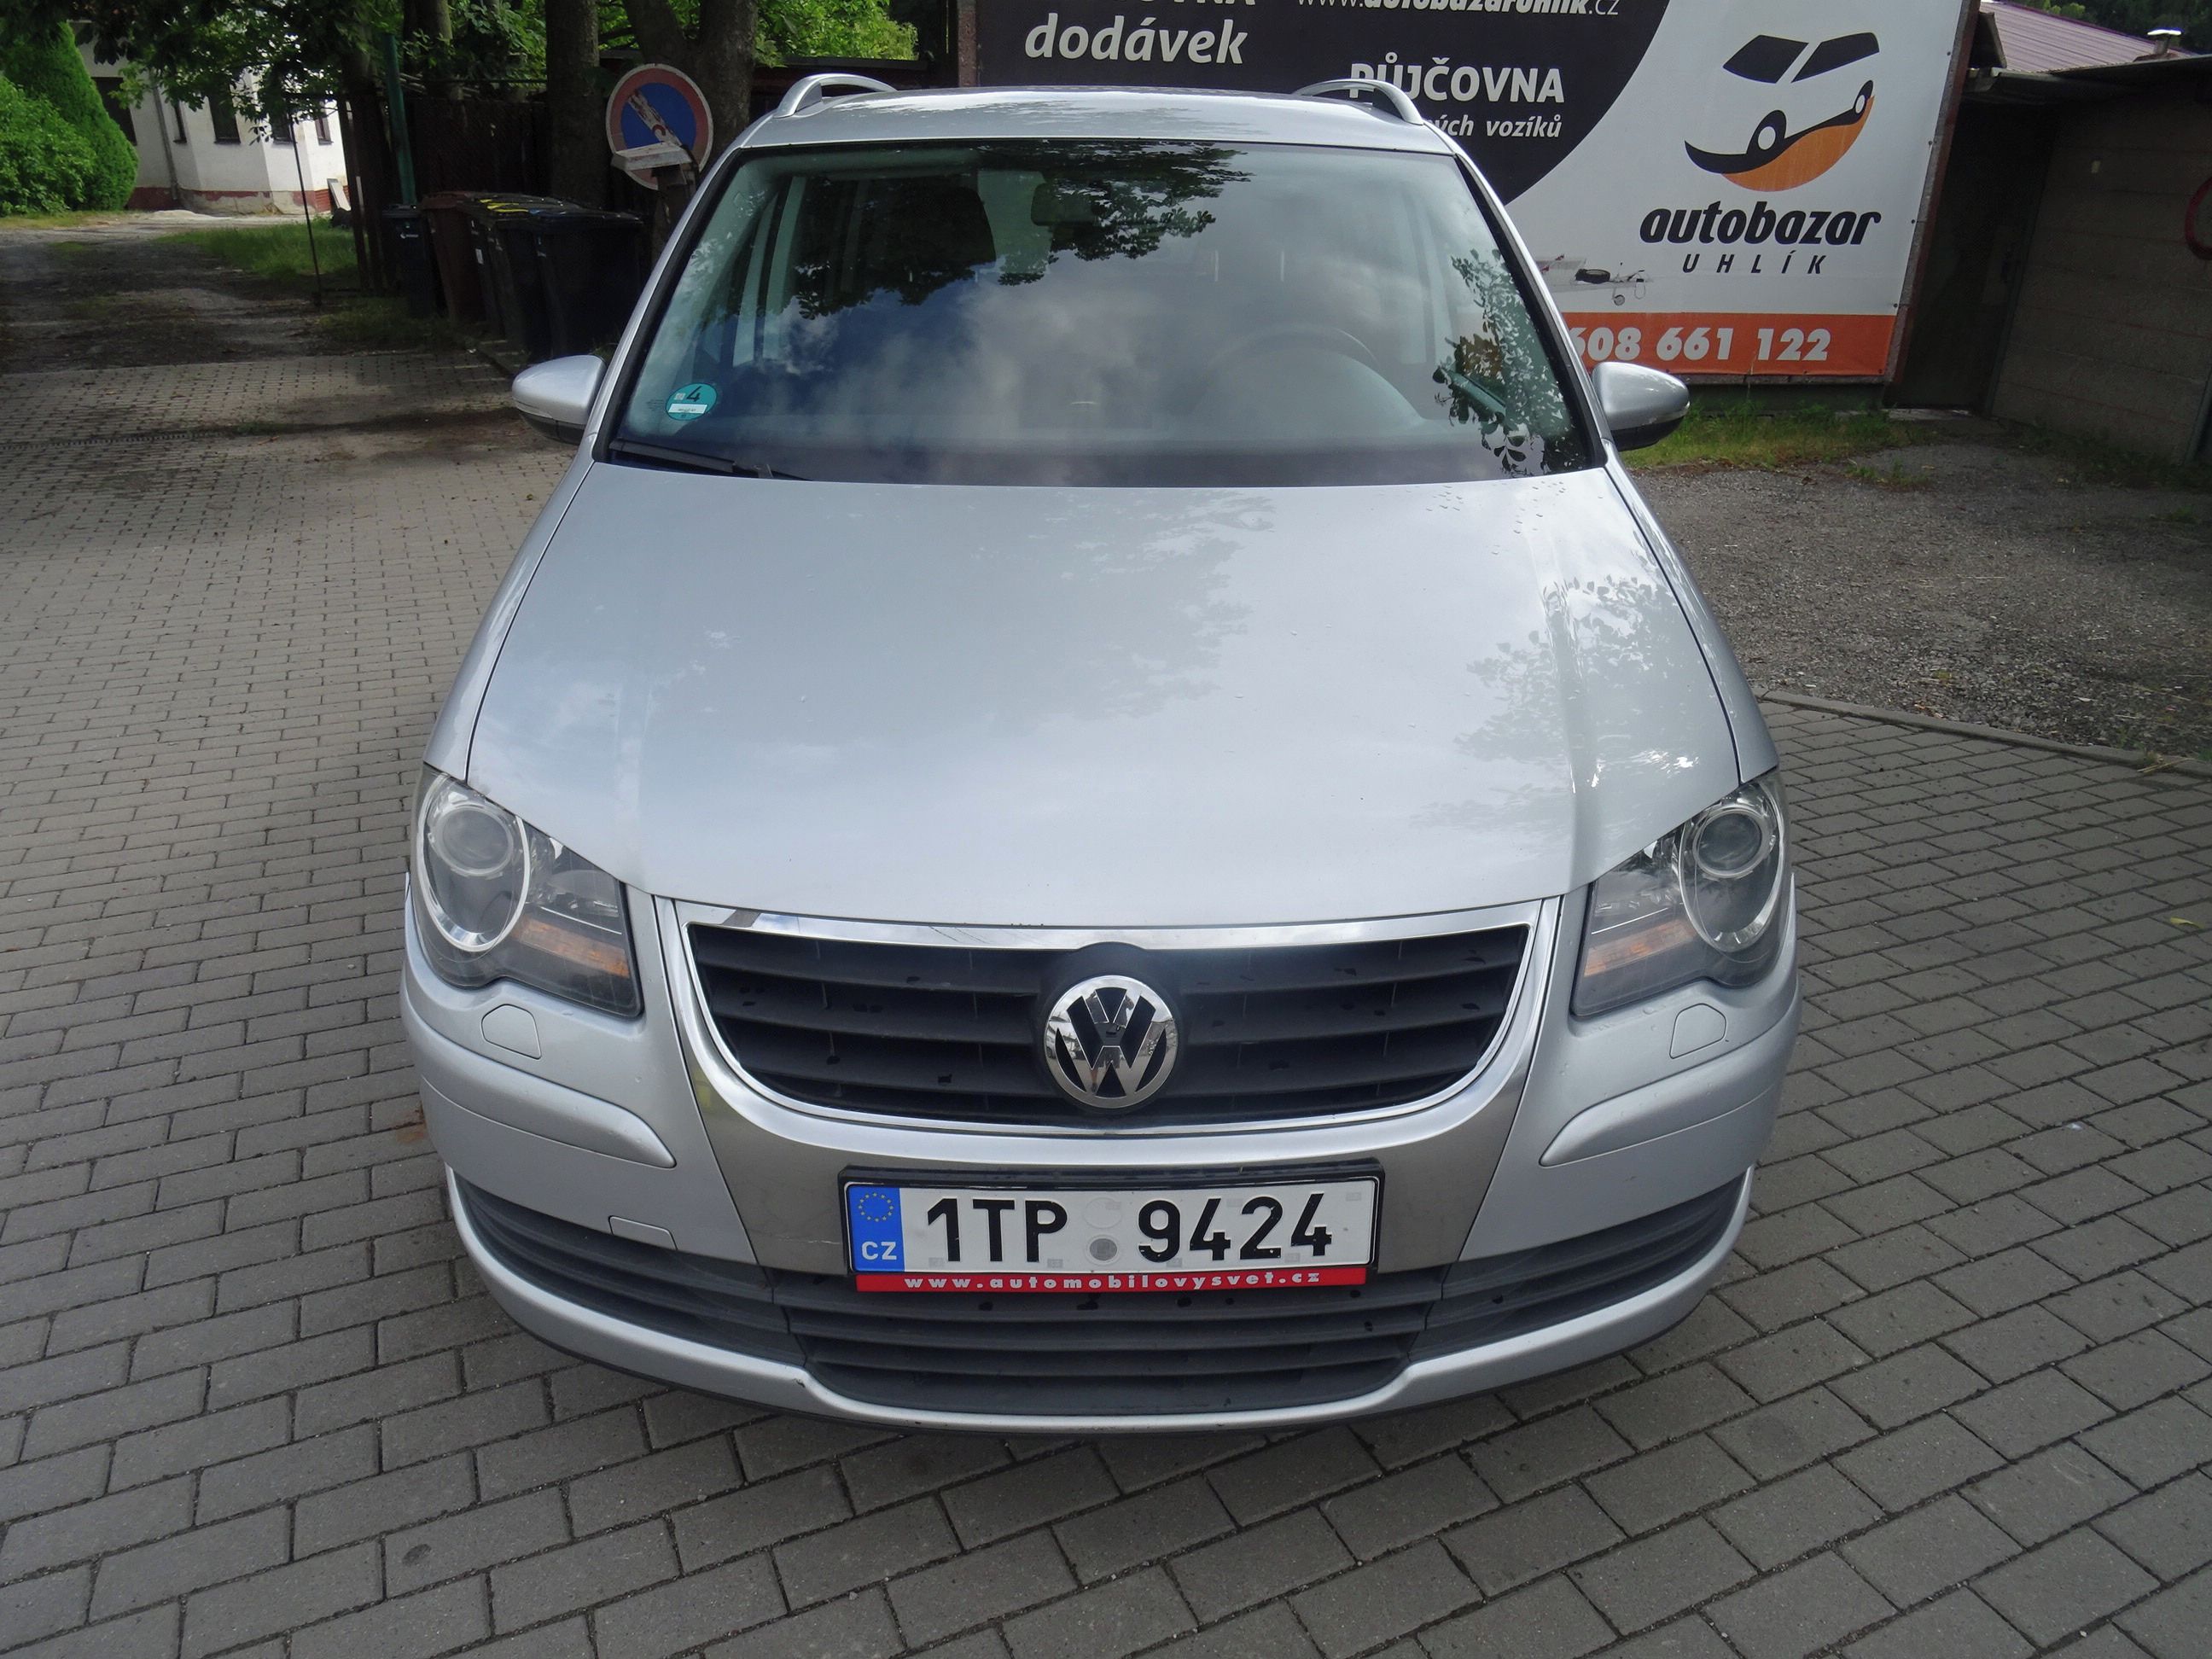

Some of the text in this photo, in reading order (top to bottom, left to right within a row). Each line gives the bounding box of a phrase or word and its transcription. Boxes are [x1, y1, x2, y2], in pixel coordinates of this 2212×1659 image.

[1025, 12, 1249, 64] dodávek
[1348, 51, 1565, 103] PŮJČOVNA
[1427, 114, 1563, 137] ých vozíků
[1639, 201, 1882, 245] autobazar
[1656, 327, 1734, 361] 661
[1756, 328, 1831, 361] 122
[686, 385, 702, 402] 4
[927, 1192, 1333, 1263] 1TP 9424
[861, 1241, 897, 1260] CZ
[905, 1271, 1320, 1290] www.automobilovysvet.cz
